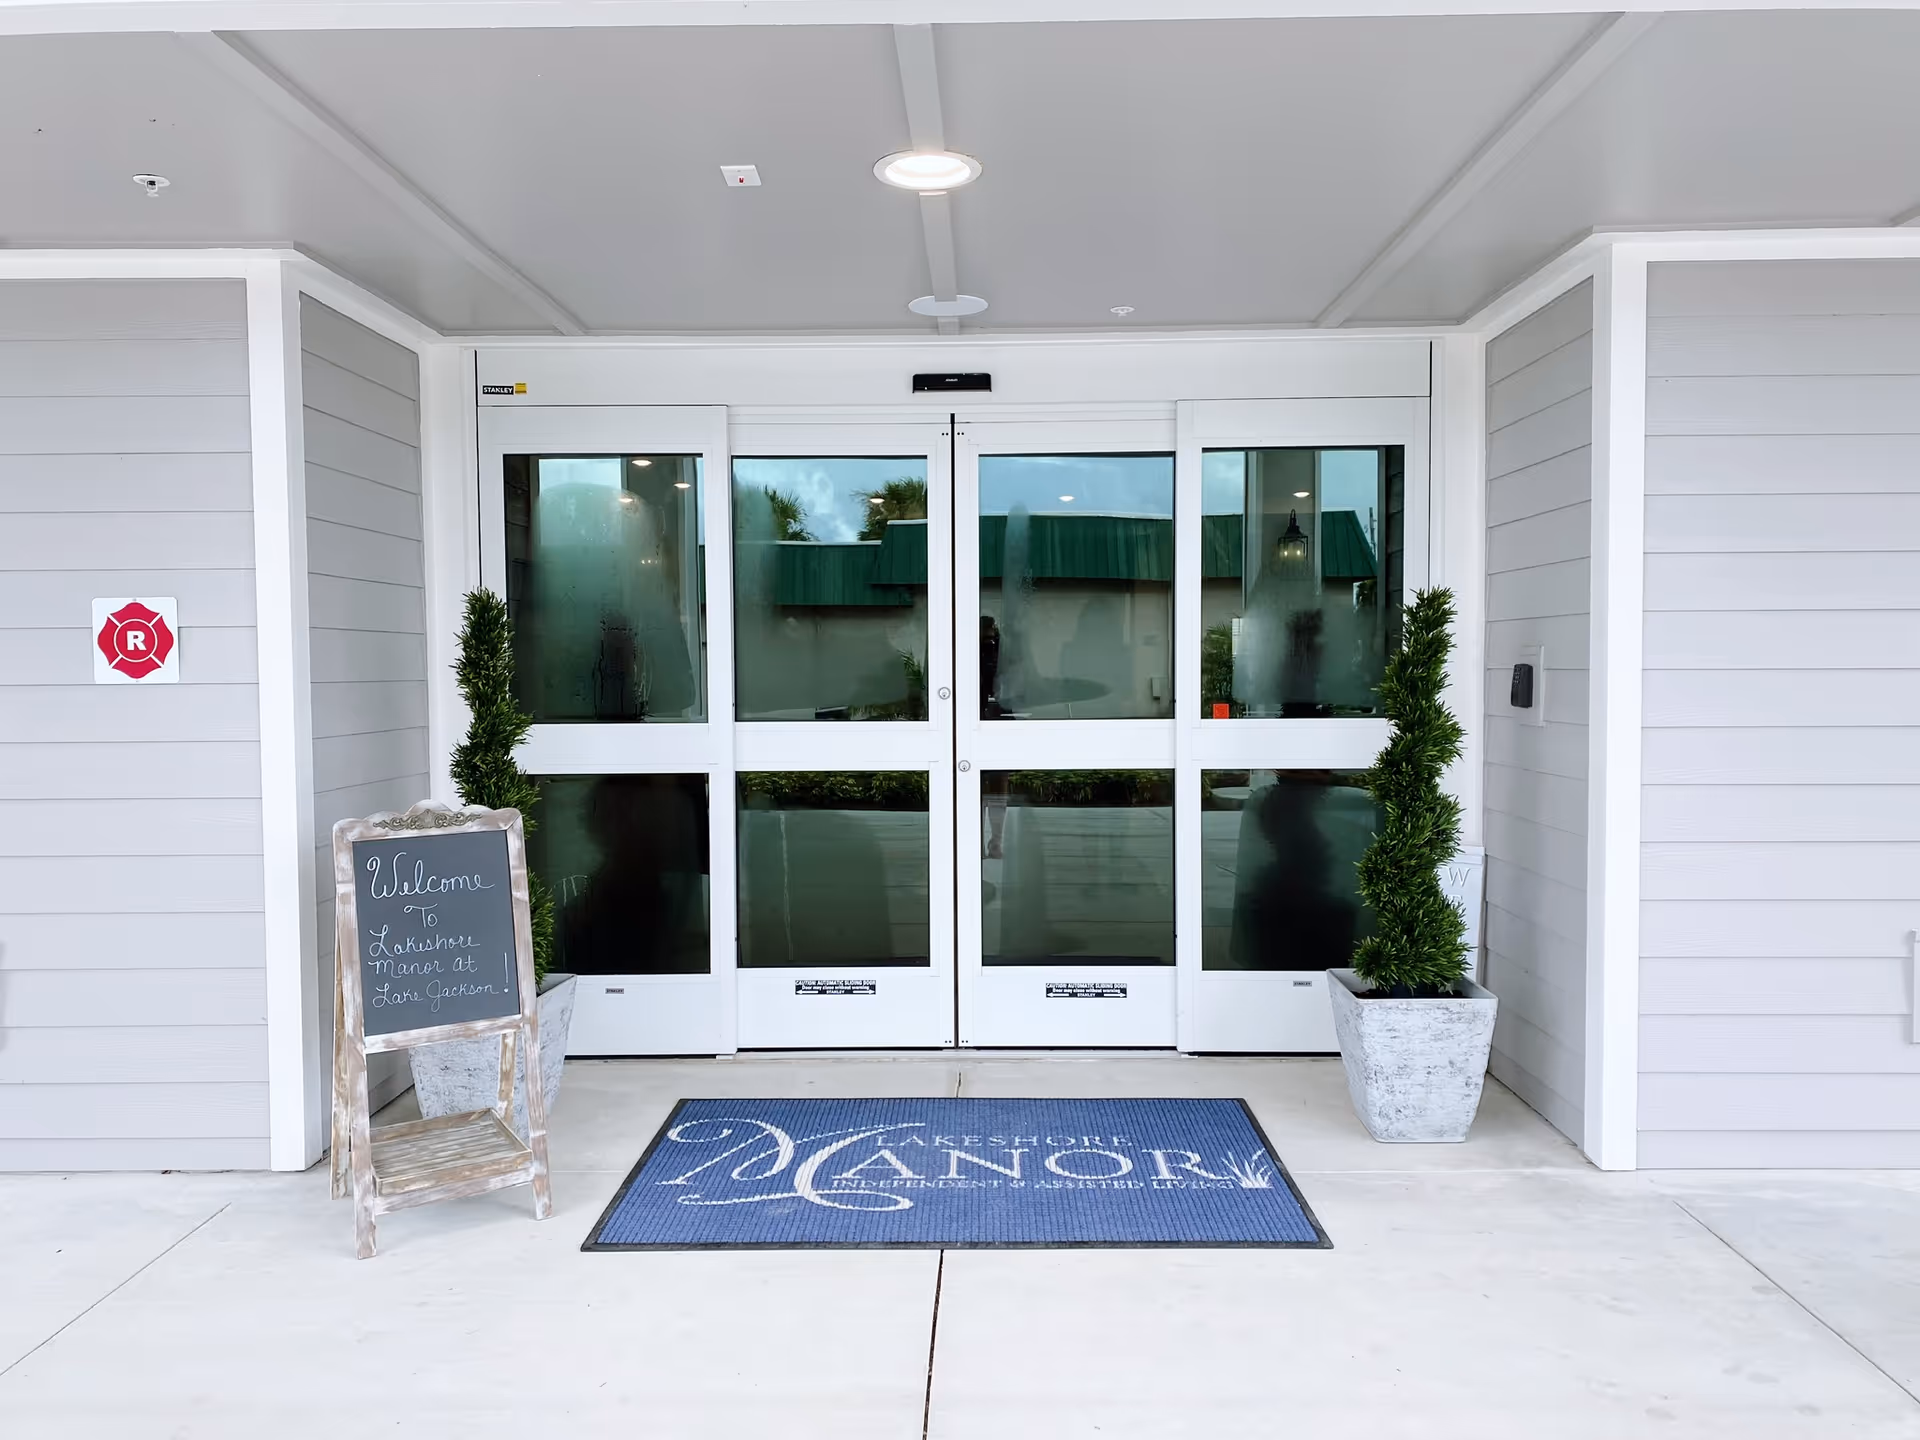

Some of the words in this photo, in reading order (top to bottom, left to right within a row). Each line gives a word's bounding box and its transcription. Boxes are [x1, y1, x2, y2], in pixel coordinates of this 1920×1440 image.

[483, 386, 513, 394] STANLEY
[126, 630, 147, 651] R
[366, 851, 496, 900] Welcome
[403, 903, 438, 928] To
[368, 924, 481, 957] Lakeshore
[372, 982, 424, 1008] Lake
[876, 1135, 1133, 1147] LAKESHORE
[831, 1179, 1002, 1189] INDEPENDENT
[1034, 1180, 1144, 1189] ASSISTED
[1152, 1180, 1235, 1189] LIVING
